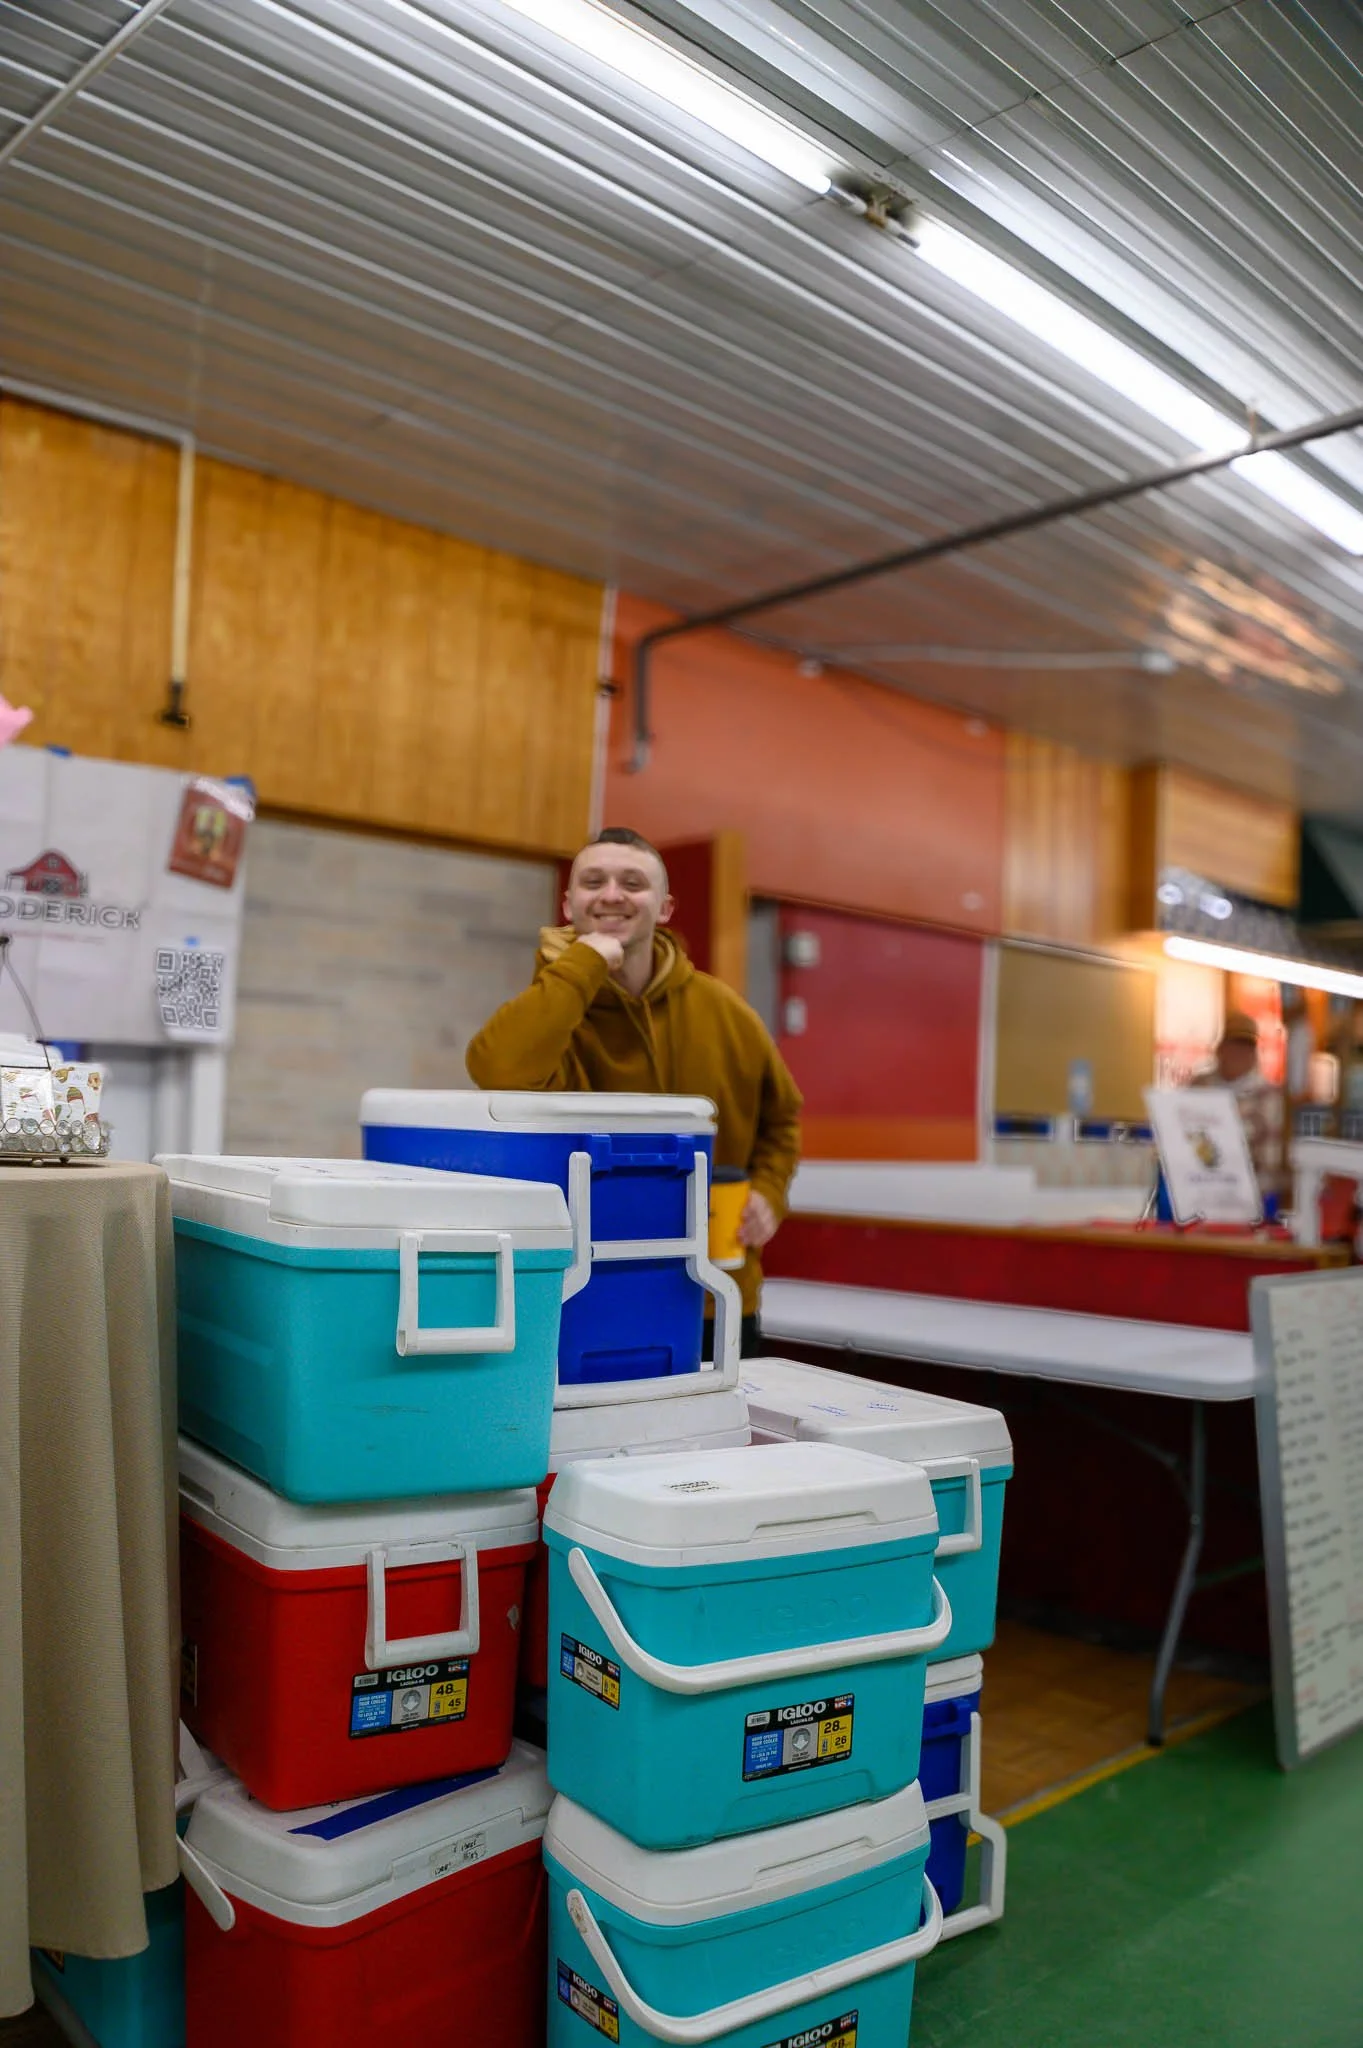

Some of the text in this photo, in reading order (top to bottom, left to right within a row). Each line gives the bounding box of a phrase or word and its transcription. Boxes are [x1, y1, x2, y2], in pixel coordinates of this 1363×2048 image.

[386, 1664, 439, 1683] IGLOO
[436, 1683, 454, 1695] 48
[448, 1698, 461, 1707] 45
[777, 1701, 827, 1721] IGLOO
[824, 1720, 841, 1734] 28
[787, 2023, 833, 2048] IGLOO
